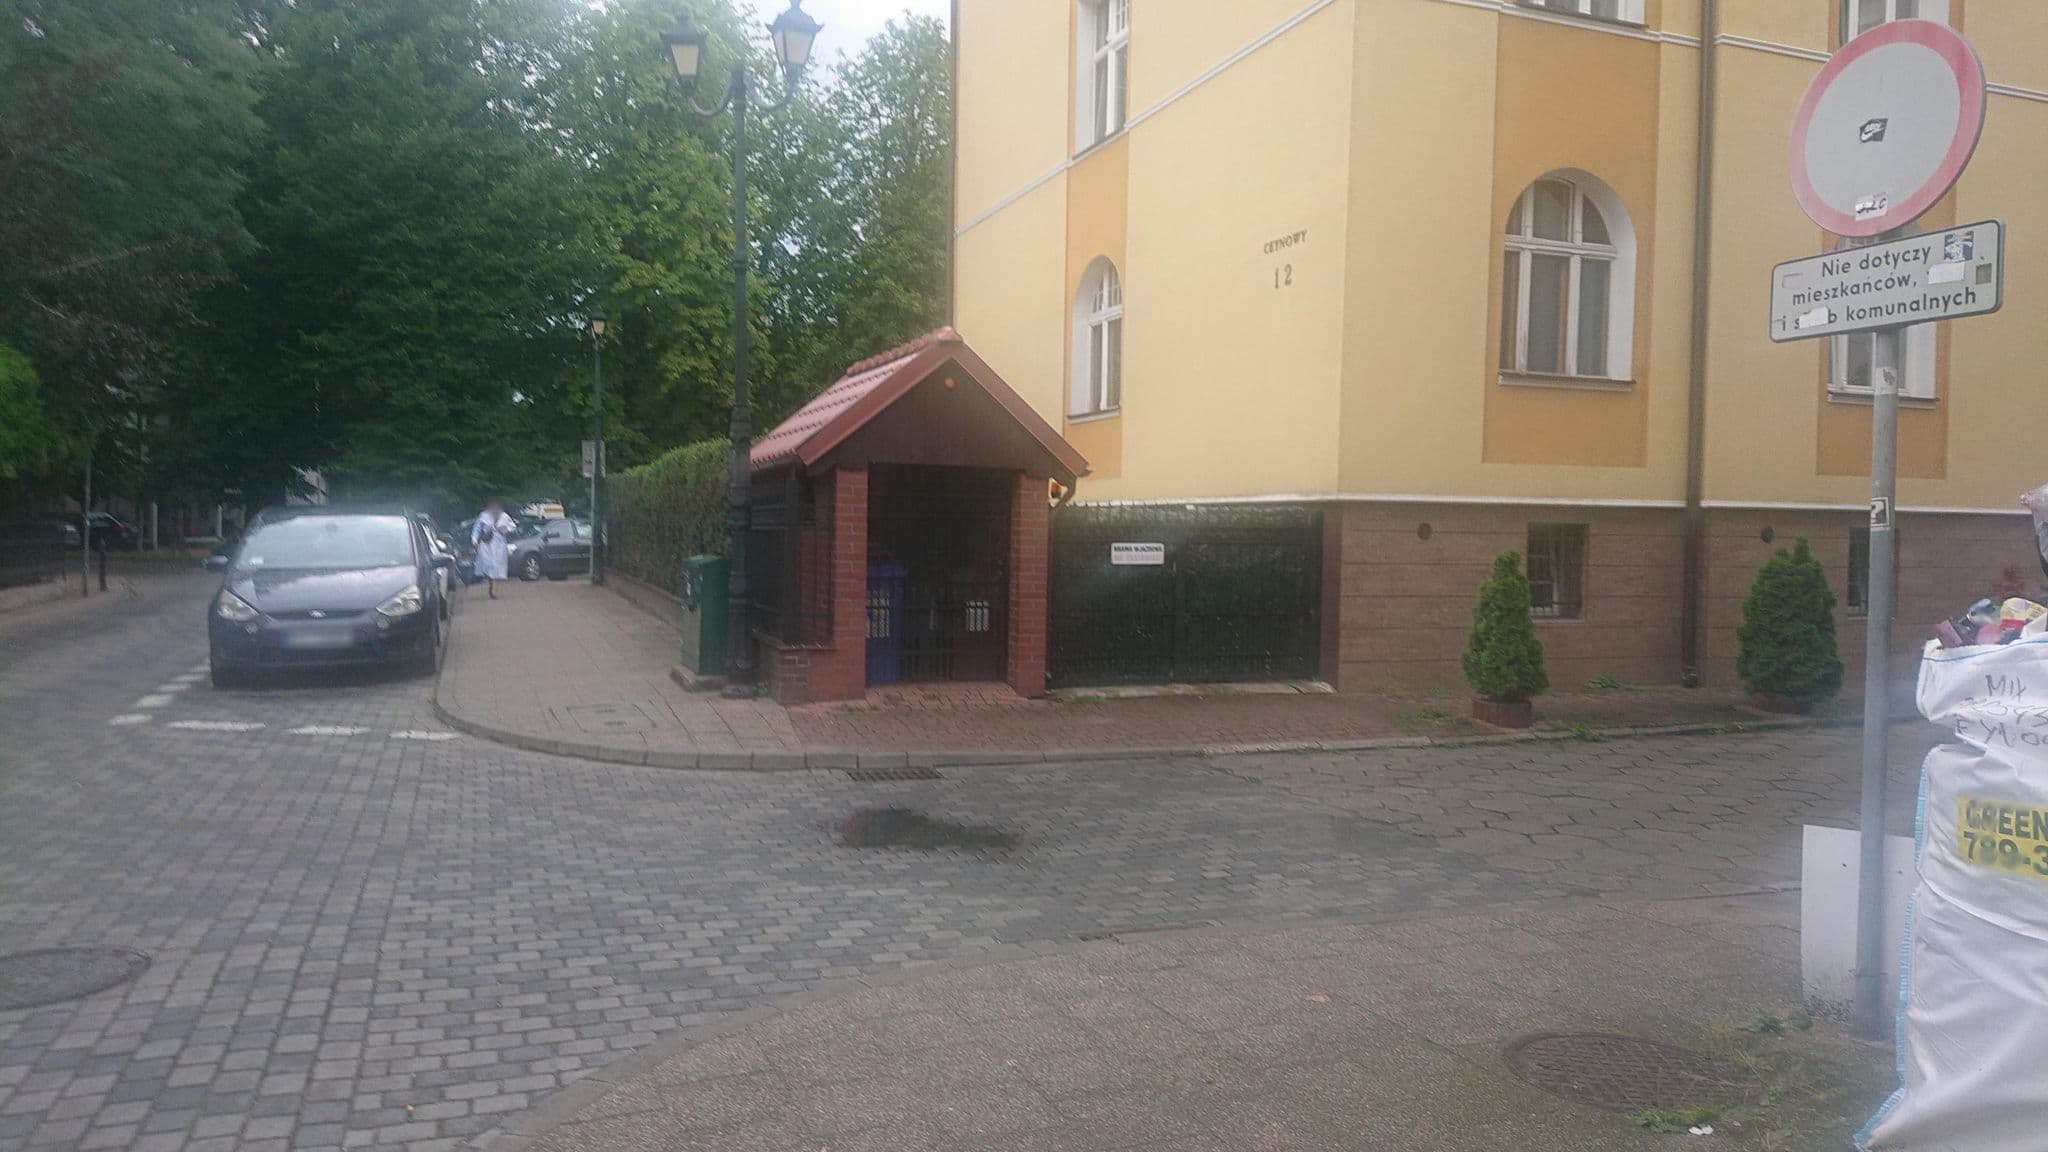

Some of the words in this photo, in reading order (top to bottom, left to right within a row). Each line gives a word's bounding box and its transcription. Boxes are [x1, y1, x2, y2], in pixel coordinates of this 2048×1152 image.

[1274, 263, 1293, 289] 12
[1821, 258, 1851, 278] Nie
[1859, 245, 1932, 271] dotyczy
[1792, 272, 1918, 306] mieszkańców,
[1781, 315, 1787, 332] i
[1846, 286, 1977, 322] komunalnych
